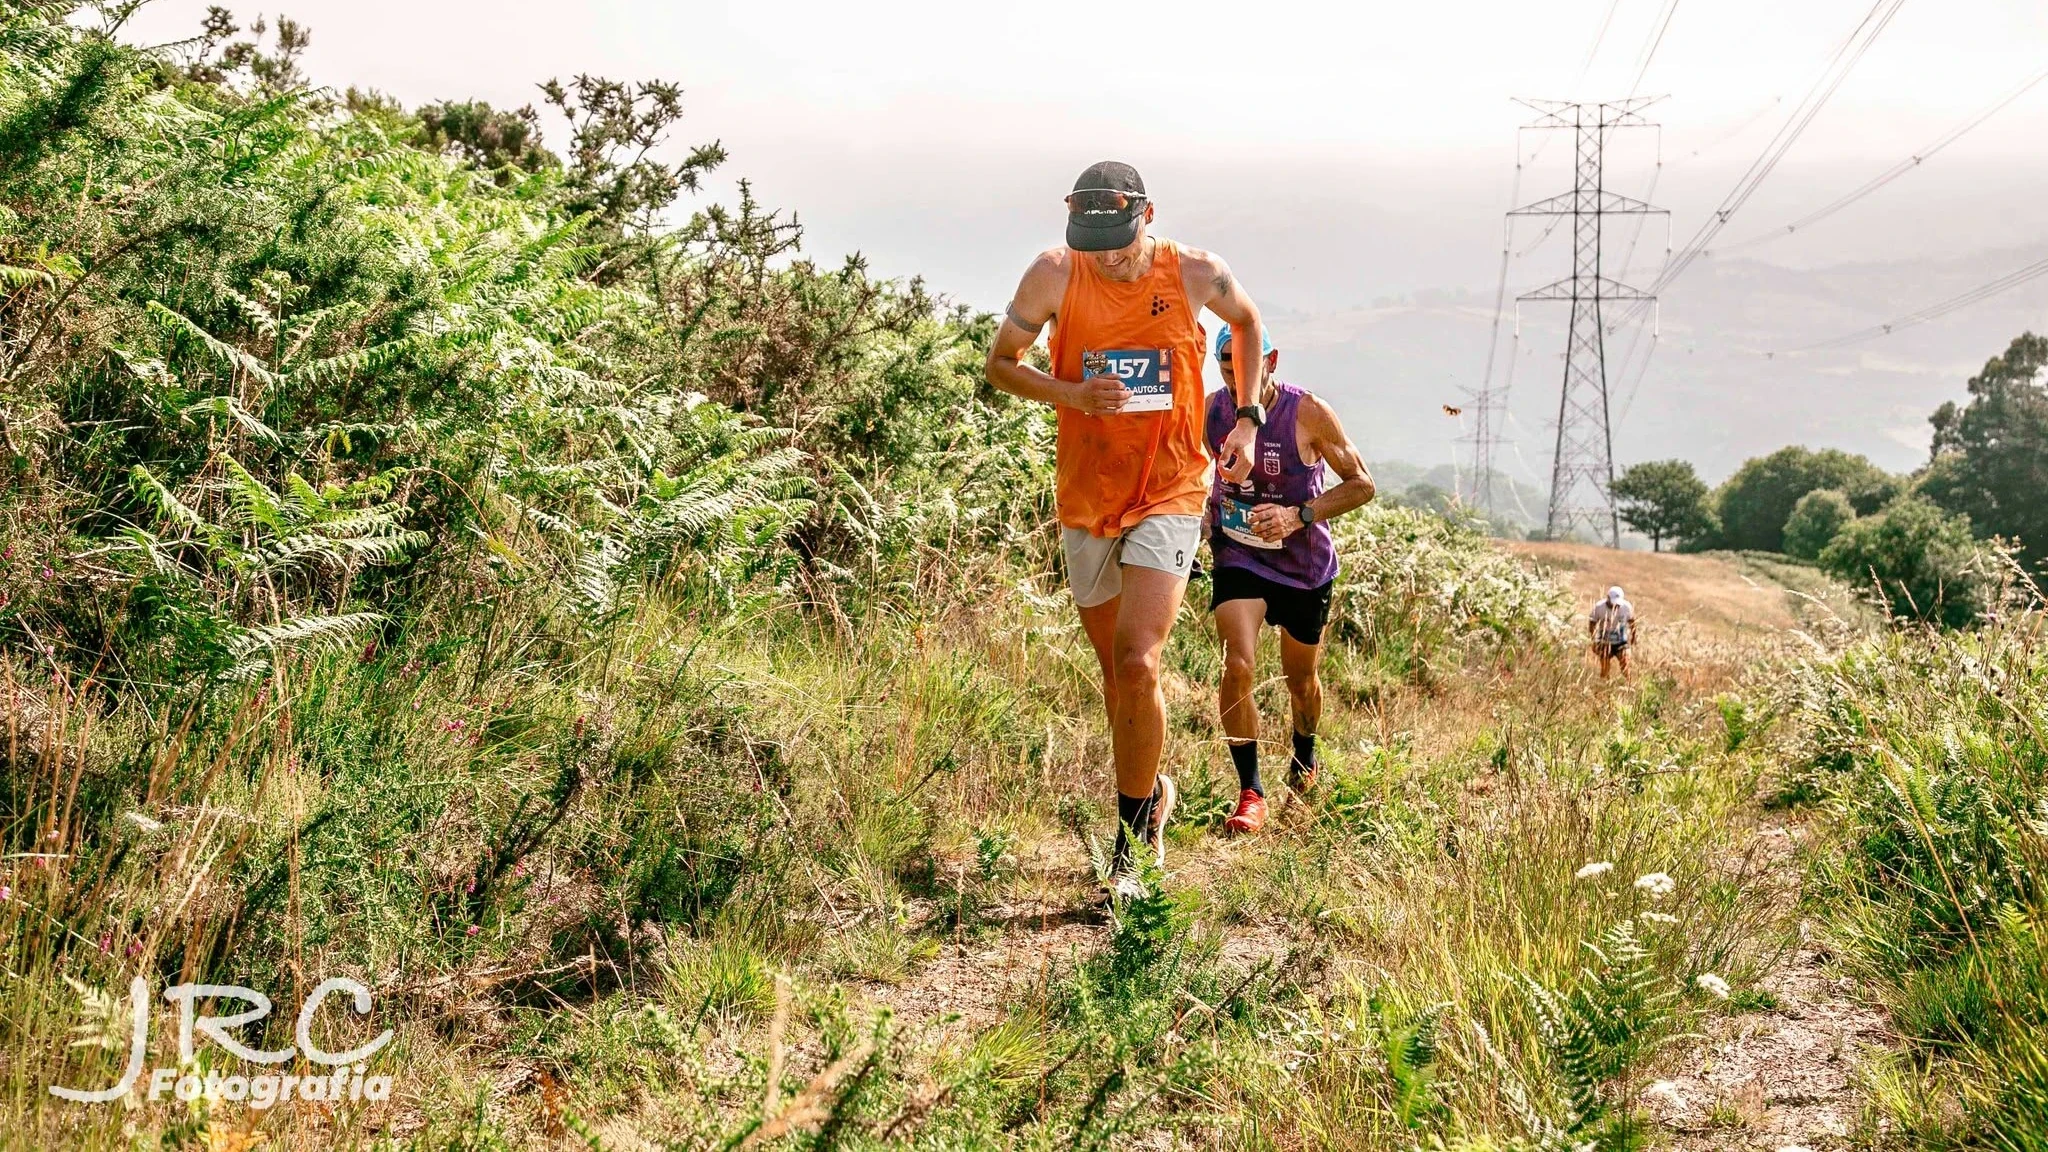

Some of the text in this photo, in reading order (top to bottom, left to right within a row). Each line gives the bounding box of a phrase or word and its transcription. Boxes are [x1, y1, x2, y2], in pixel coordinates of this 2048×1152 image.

[1107, 358, 1150, 379] 157
[1134, 385, 1158, 394] AUTOS
[1159, 385, 1165, 393] C
